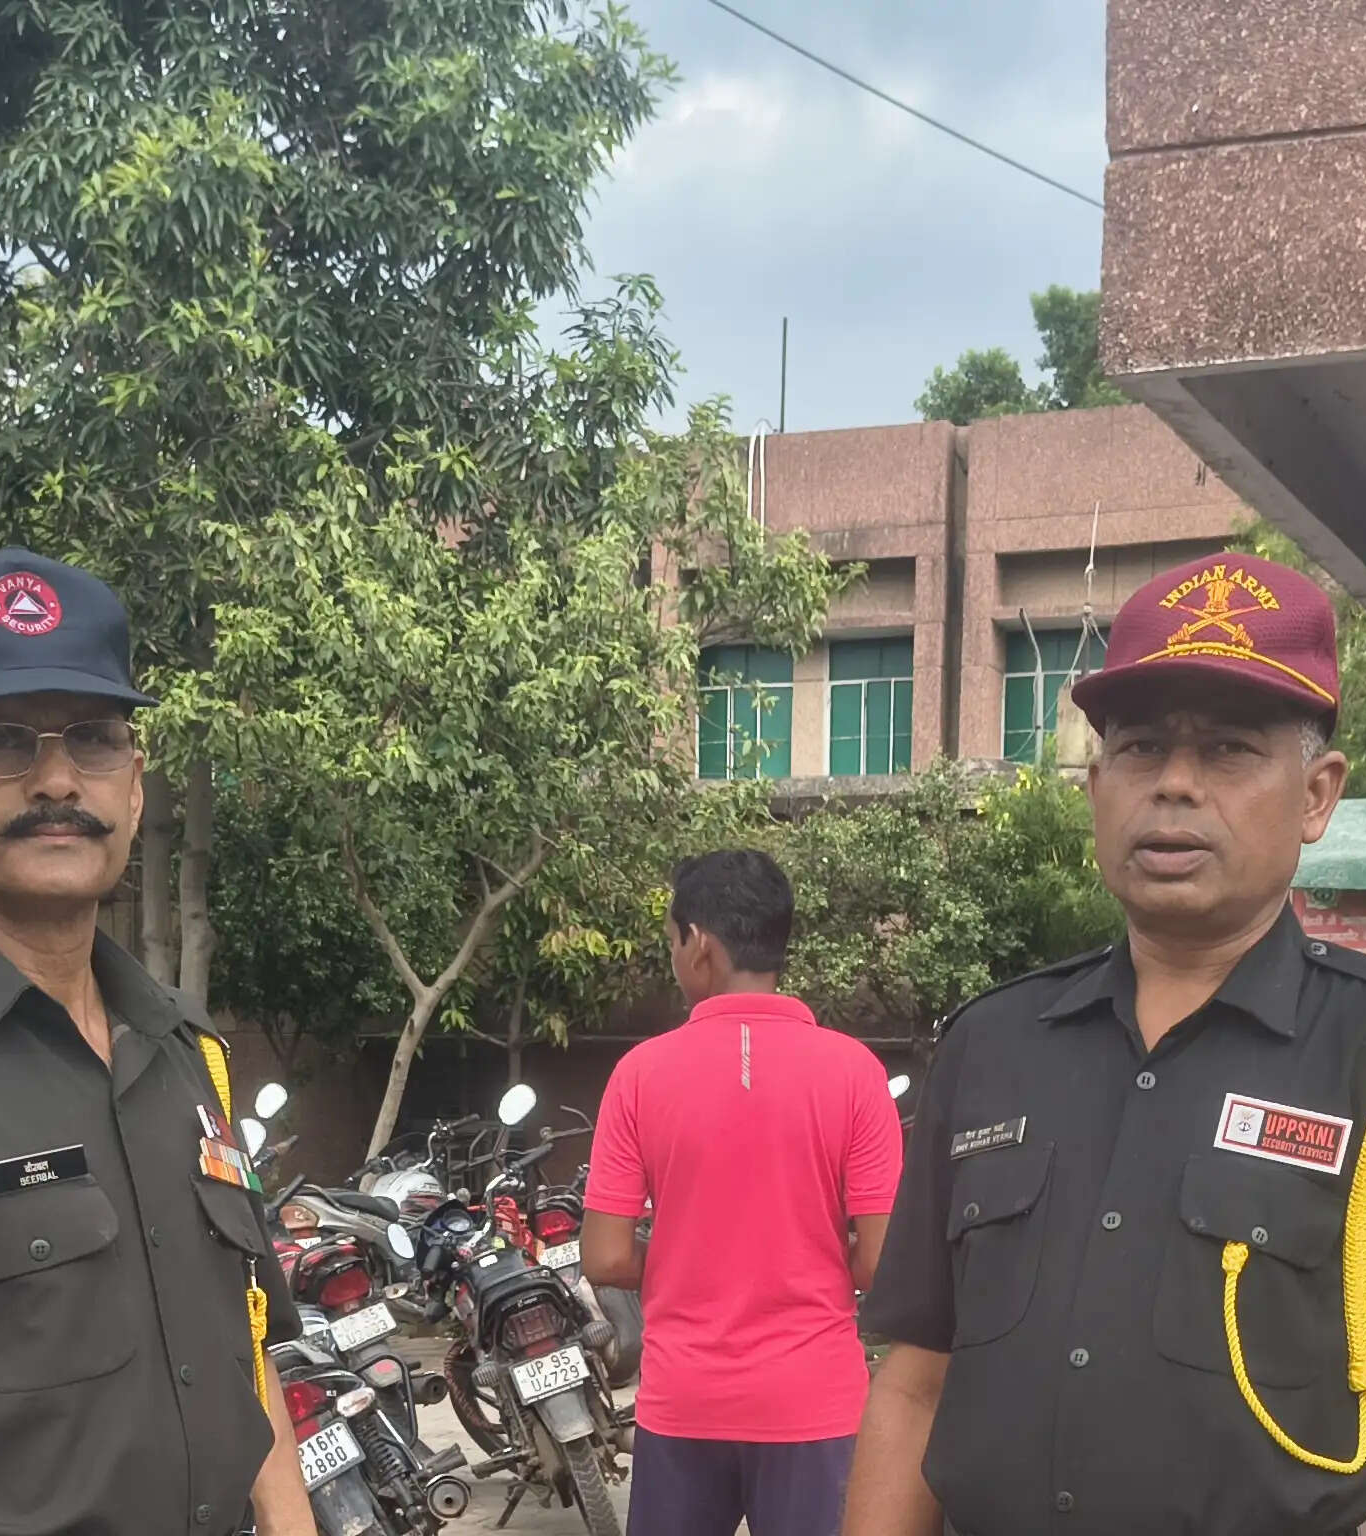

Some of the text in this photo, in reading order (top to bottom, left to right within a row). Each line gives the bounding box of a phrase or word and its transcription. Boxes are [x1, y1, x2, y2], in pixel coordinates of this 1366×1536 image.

[1159, 564, 1280, 610] INDIAN ARMY
[1, 613, 56, 633] SECURITY
[1265, 1113, 1336, 1149] UPPSKNL
[1261, 1136, 1334, 1163] SECURITY SERVICES
[526, 1351, 571, 1378] UP 95
[530, 1365, 580, 1392] U4729
[305, 1445, 348, 1480] 2880
